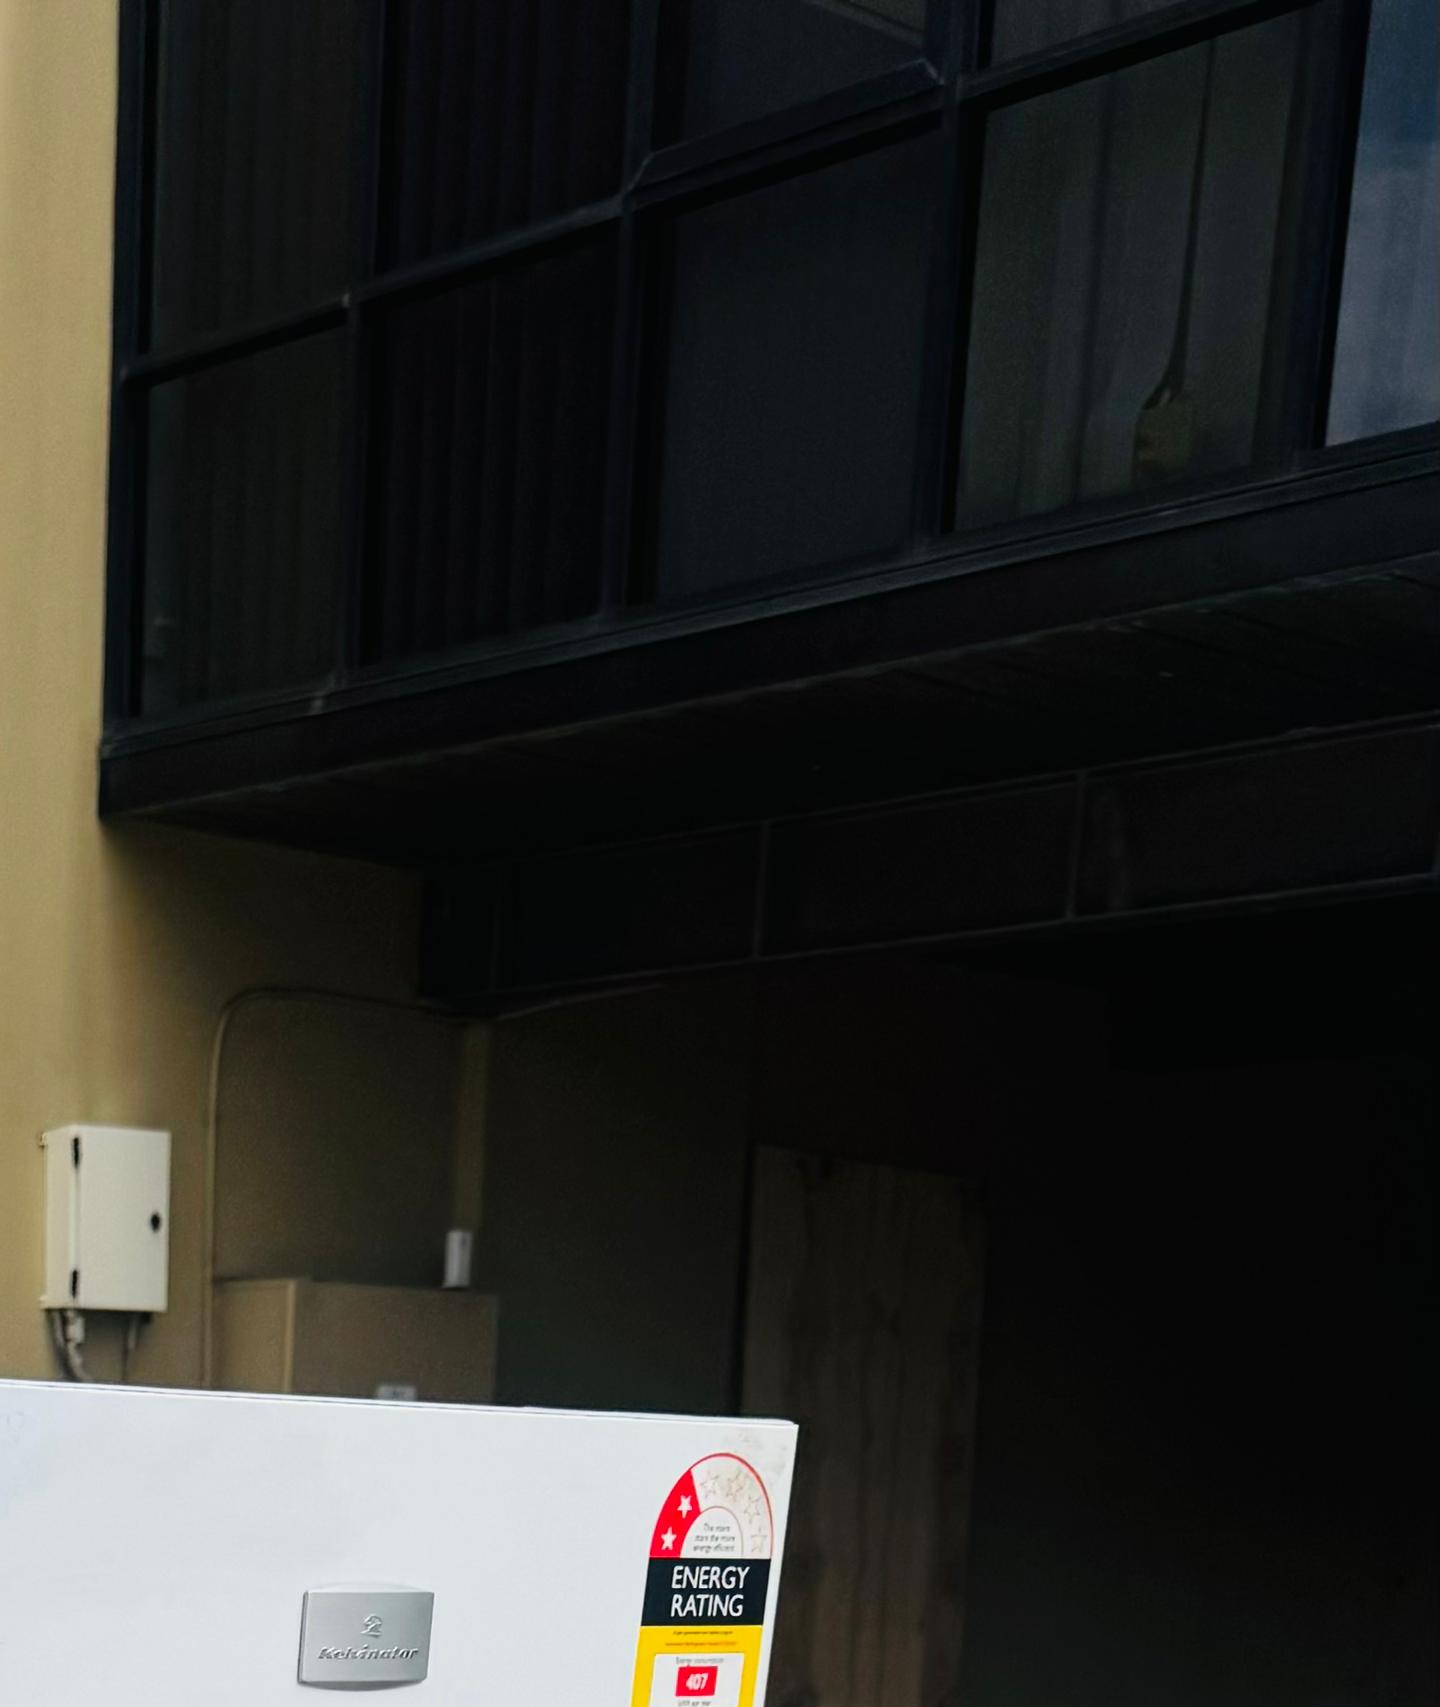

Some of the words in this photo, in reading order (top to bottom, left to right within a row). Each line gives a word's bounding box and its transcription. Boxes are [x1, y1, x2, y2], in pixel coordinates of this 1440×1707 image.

[671, 1565, 750, 1589] ENERGY
[670, 1593, 744, 1617] RATING
[685, 1672, 709, 1691] 407
